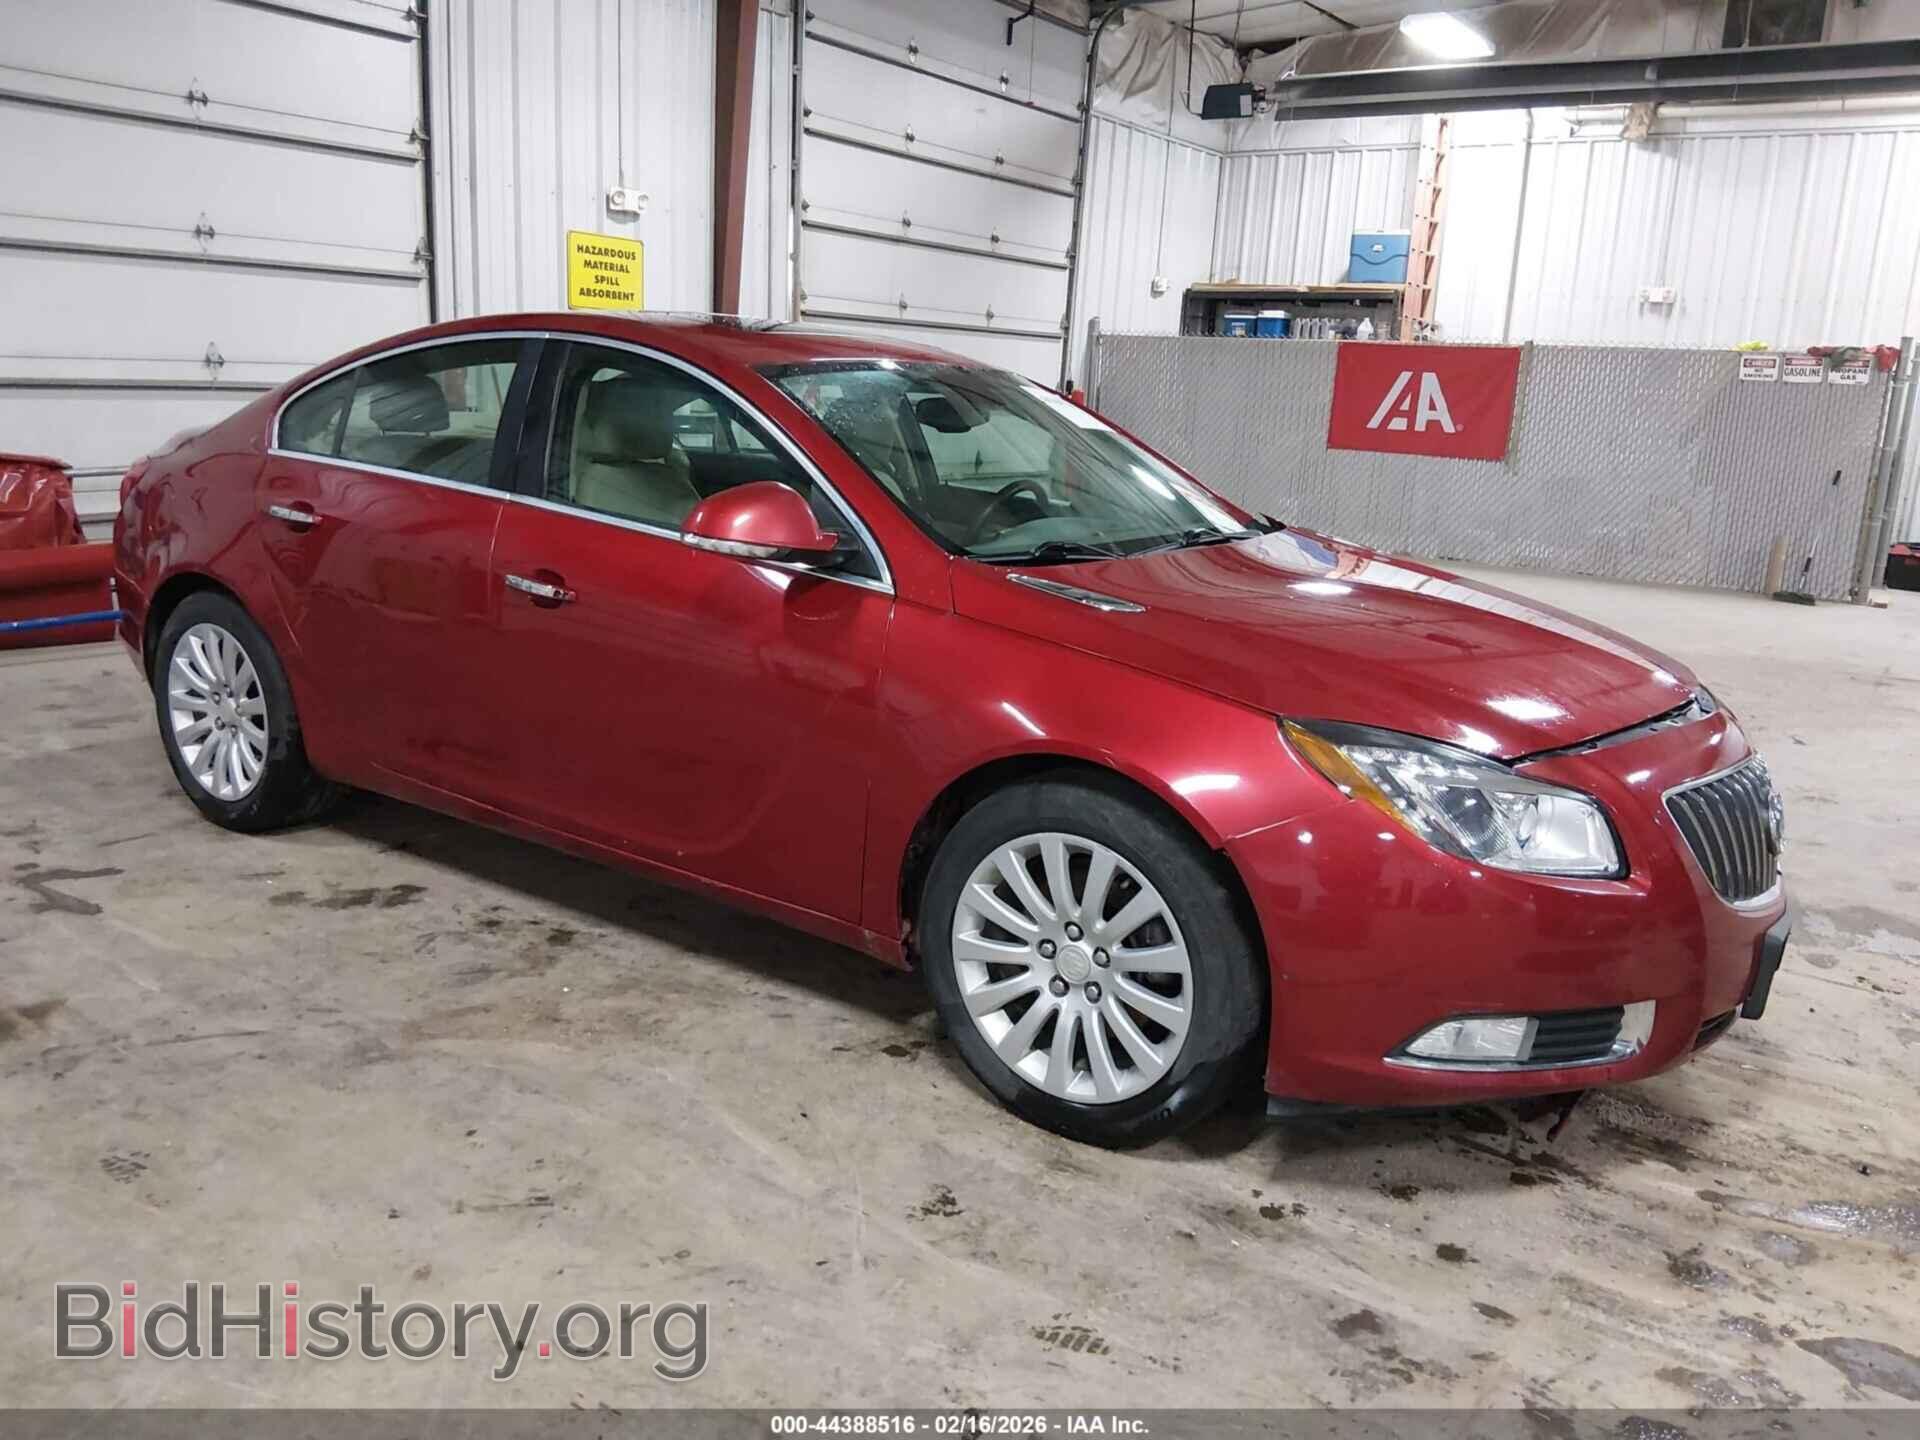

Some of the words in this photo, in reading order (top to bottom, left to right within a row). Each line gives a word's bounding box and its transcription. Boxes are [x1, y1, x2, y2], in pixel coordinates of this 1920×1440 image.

[576, 244, 636, 261] HAZARDOUS
[583, 259, 630, 274] MATERIAL
[594, 274, 620, 286] SPILL
[579, 287, 635, 302] ABSORBENT
[1784, 367, 1820, 377] GASOLINE
